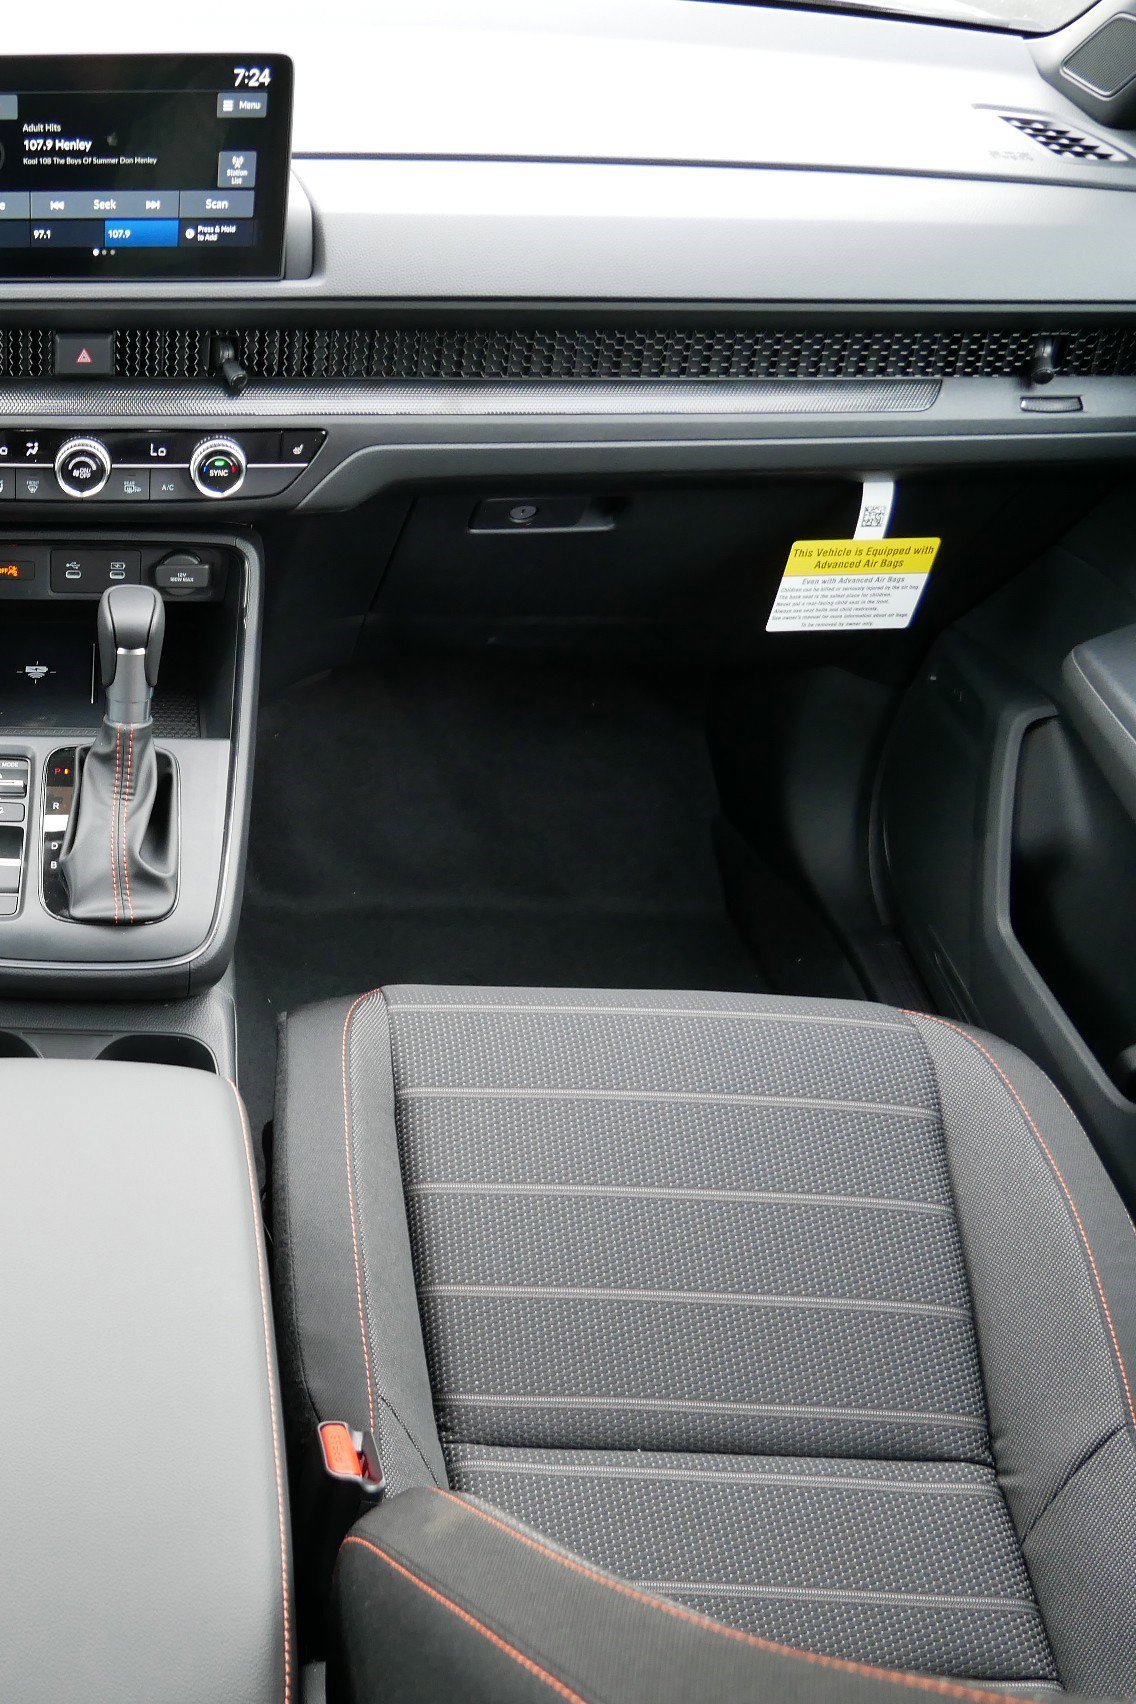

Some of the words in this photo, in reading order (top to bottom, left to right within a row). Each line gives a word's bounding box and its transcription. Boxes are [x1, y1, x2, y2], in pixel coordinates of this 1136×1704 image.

[234, 68, 271, 87] 7:24
[240, 101, 261, 110] Menu
[23, 124, 43, 132] Adult
[46, 124, 61, 132] Hits
[24, 140, 53, 150] 107.9
[56, 139, 92, 152] Henley
[66, 158, 81, 166] Boys
[135, 157, 157, 165] Henley
[231, 177, 242, 185] List
[93, 199, 116, 210] Seek
[206, 199, 228, 209] Scan
[108, 229, 131, 239] 107.9
[221, 225, 236, 233] Hold
[34, 230, 51, 239] 97.1
[150, 443, 167, 456] Lo
[794, 548, 813, 557] This
[817, 548, 851, 557] Vehicle
[854, 547, 862, 556] is
[866, 546, 911, 557] Equipped
[914, 546, 934, 555] with
[814, 559, 861, 569] Advanced
[863, 559, 878, 568] Air
[880, 559, 904, 569] Bags
